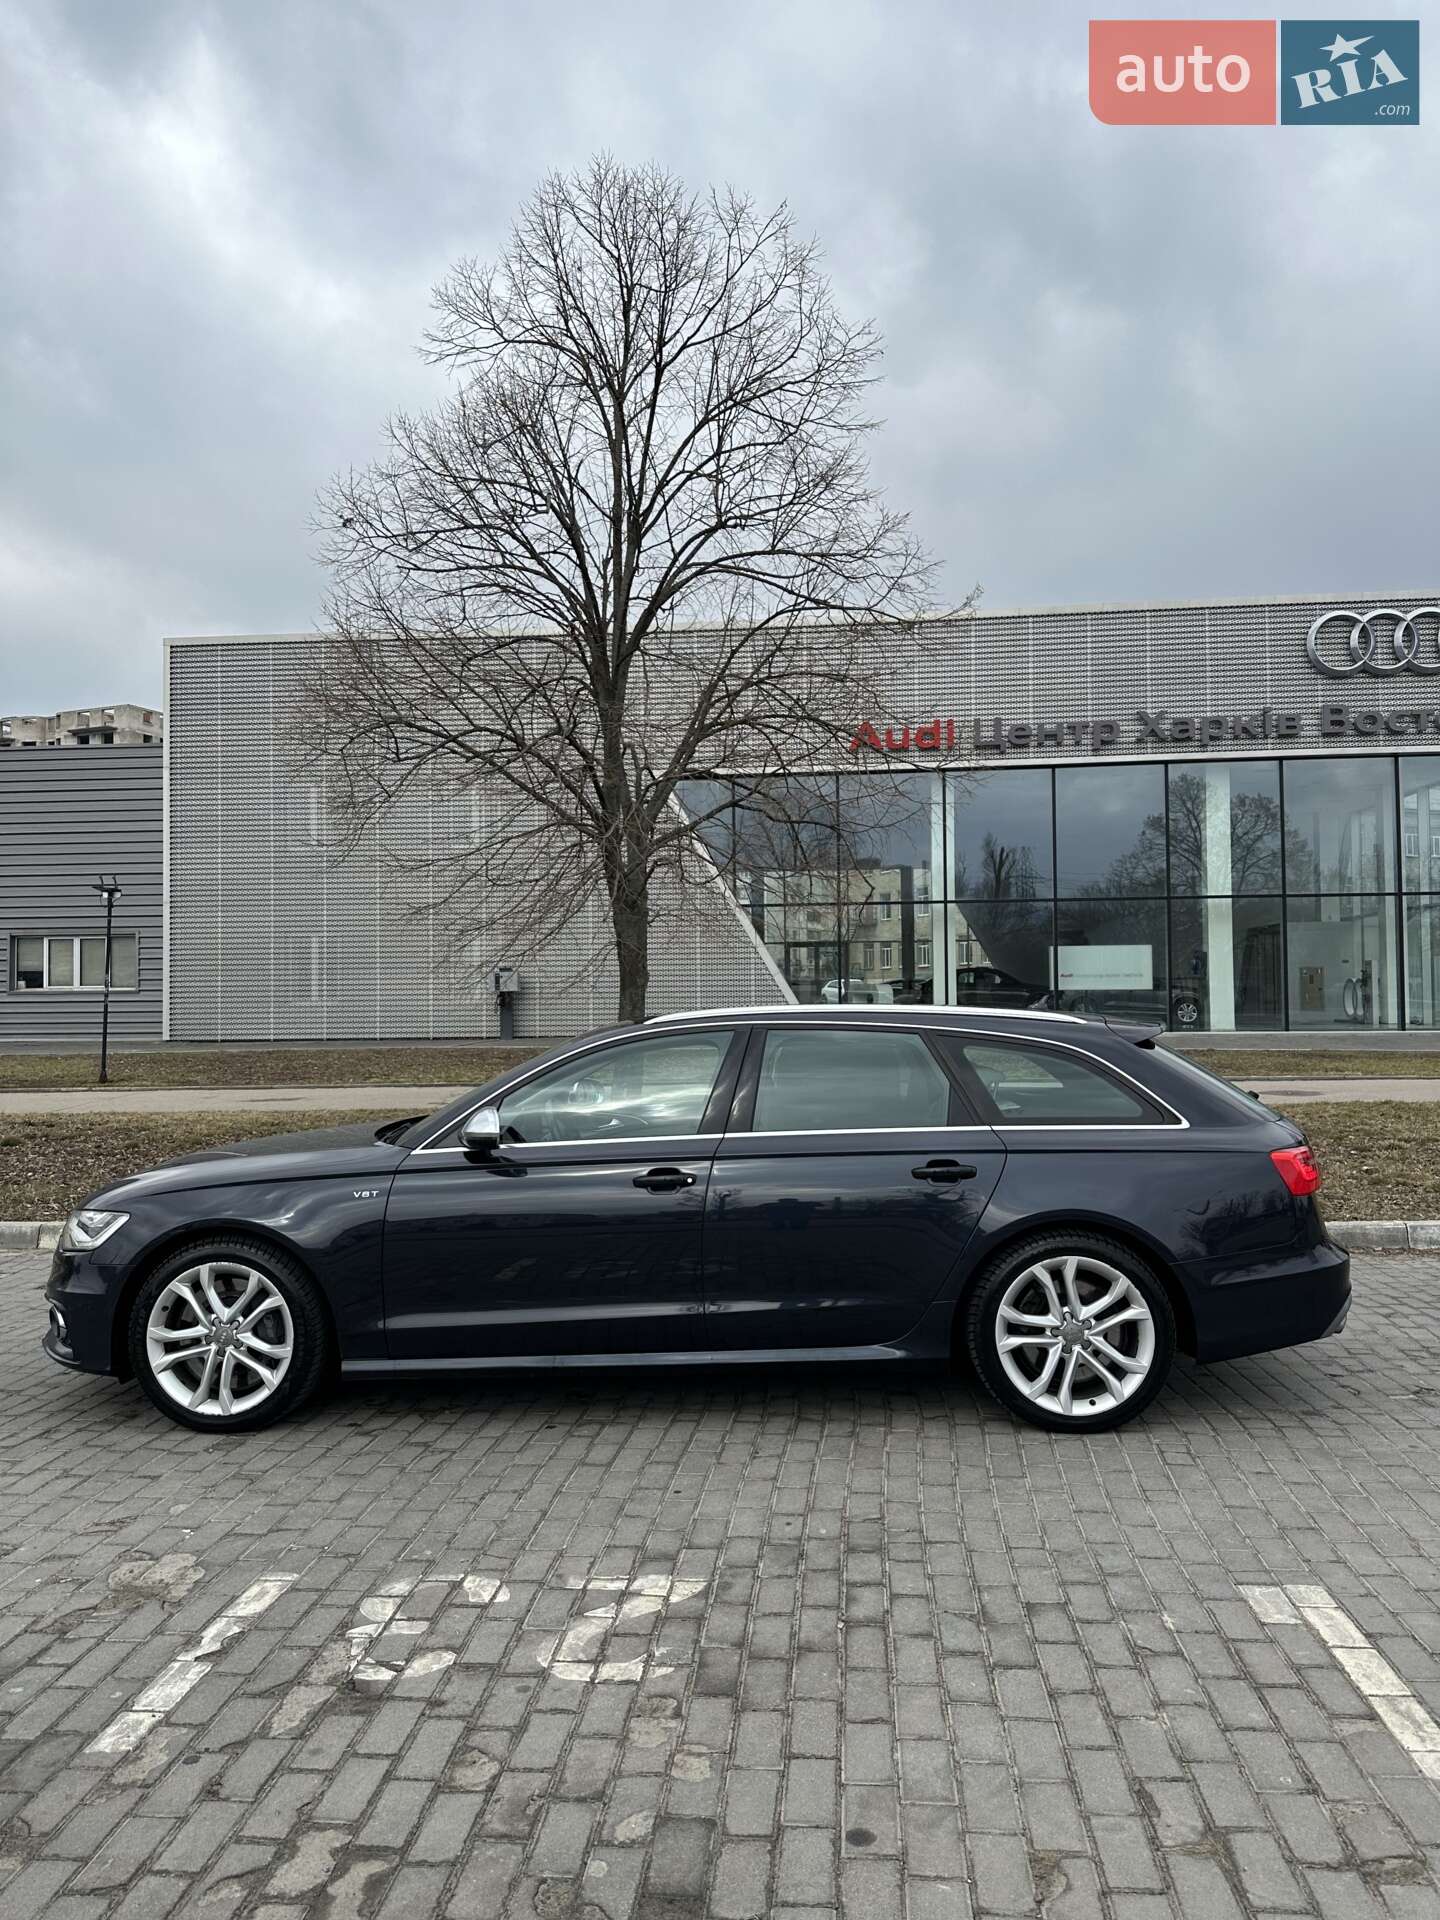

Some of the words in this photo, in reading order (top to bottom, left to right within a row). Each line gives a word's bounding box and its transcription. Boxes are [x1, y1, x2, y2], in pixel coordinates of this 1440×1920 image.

[849, 718, 955, 751] Audi
[973, 717, 1121, 754] Центр
[1136, 706, 1302, 748] Харків
[1321, 704, 1440, 736] Вост
